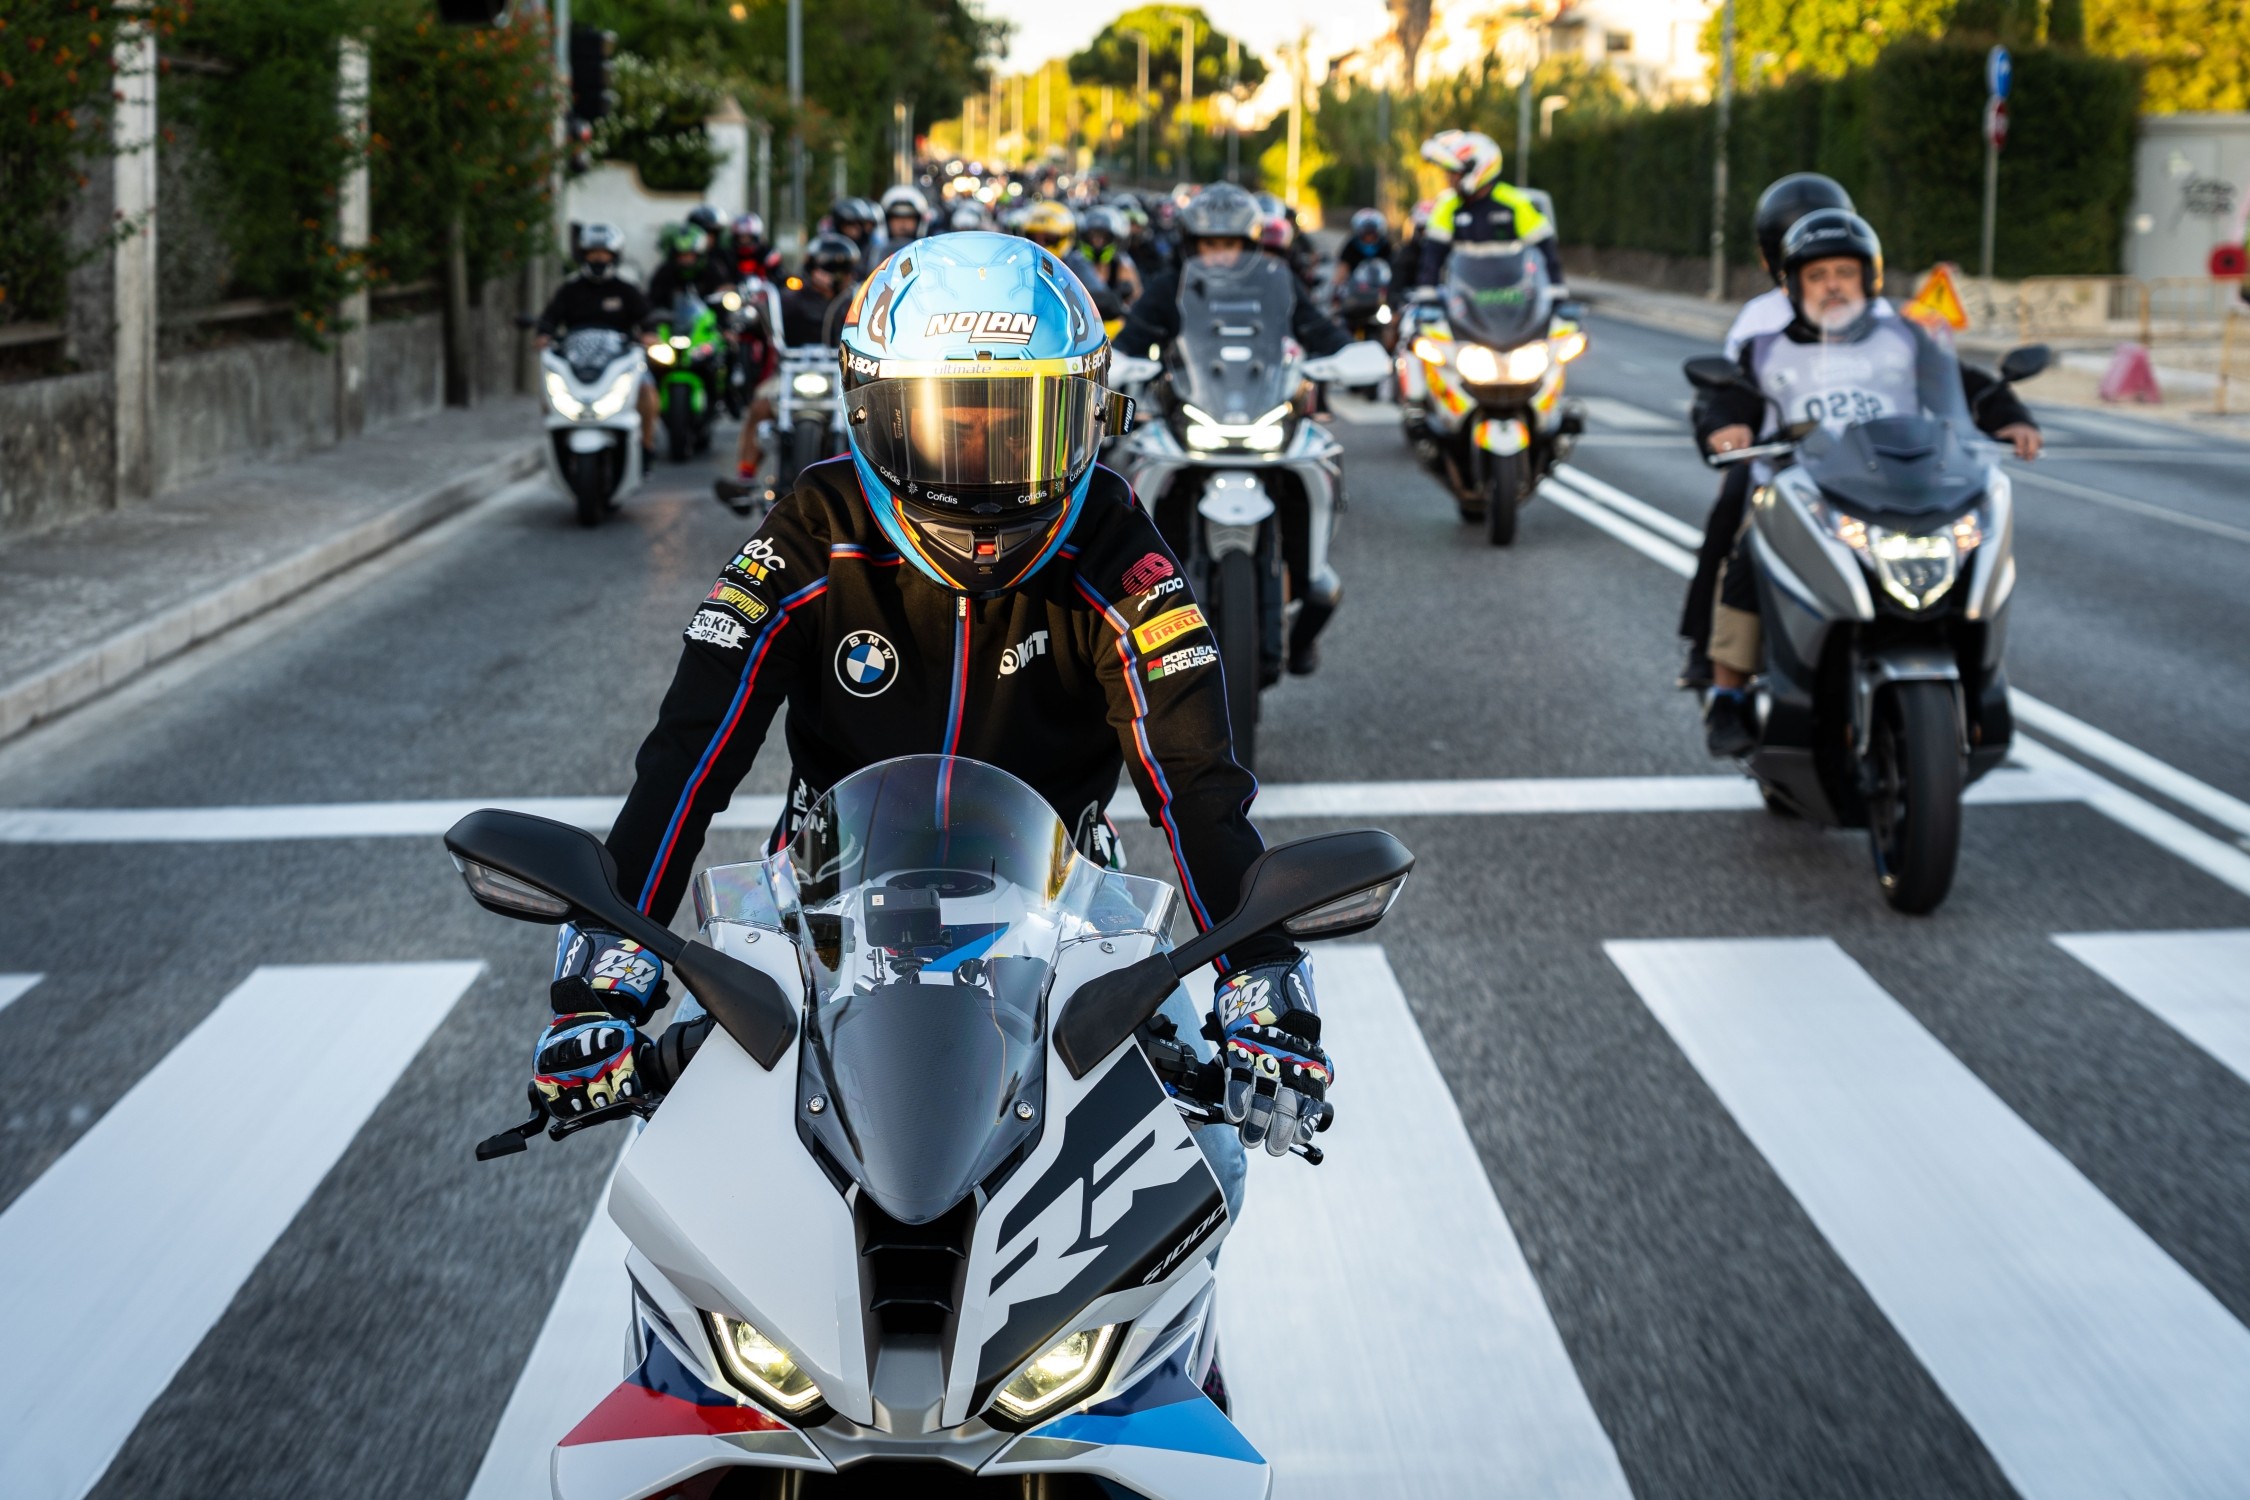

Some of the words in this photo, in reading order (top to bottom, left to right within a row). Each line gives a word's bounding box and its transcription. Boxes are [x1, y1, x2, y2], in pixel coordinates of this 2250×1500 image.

[925, 311, 1038, 345] NOLAN
[934, 363, 992, 375] ultimate
[926, 490, 958, 505] Cofidis
[1017, 489, 1048, 504] Cofidis
[743, 537, 786, 571] ebc
[700, 629, 718, 641] OFF
[849, 635, 894, 661] BMW
[1162, 645, 1218, 666] PORTUGAL
[1164, 653, 1217, 677] ENDUROS
